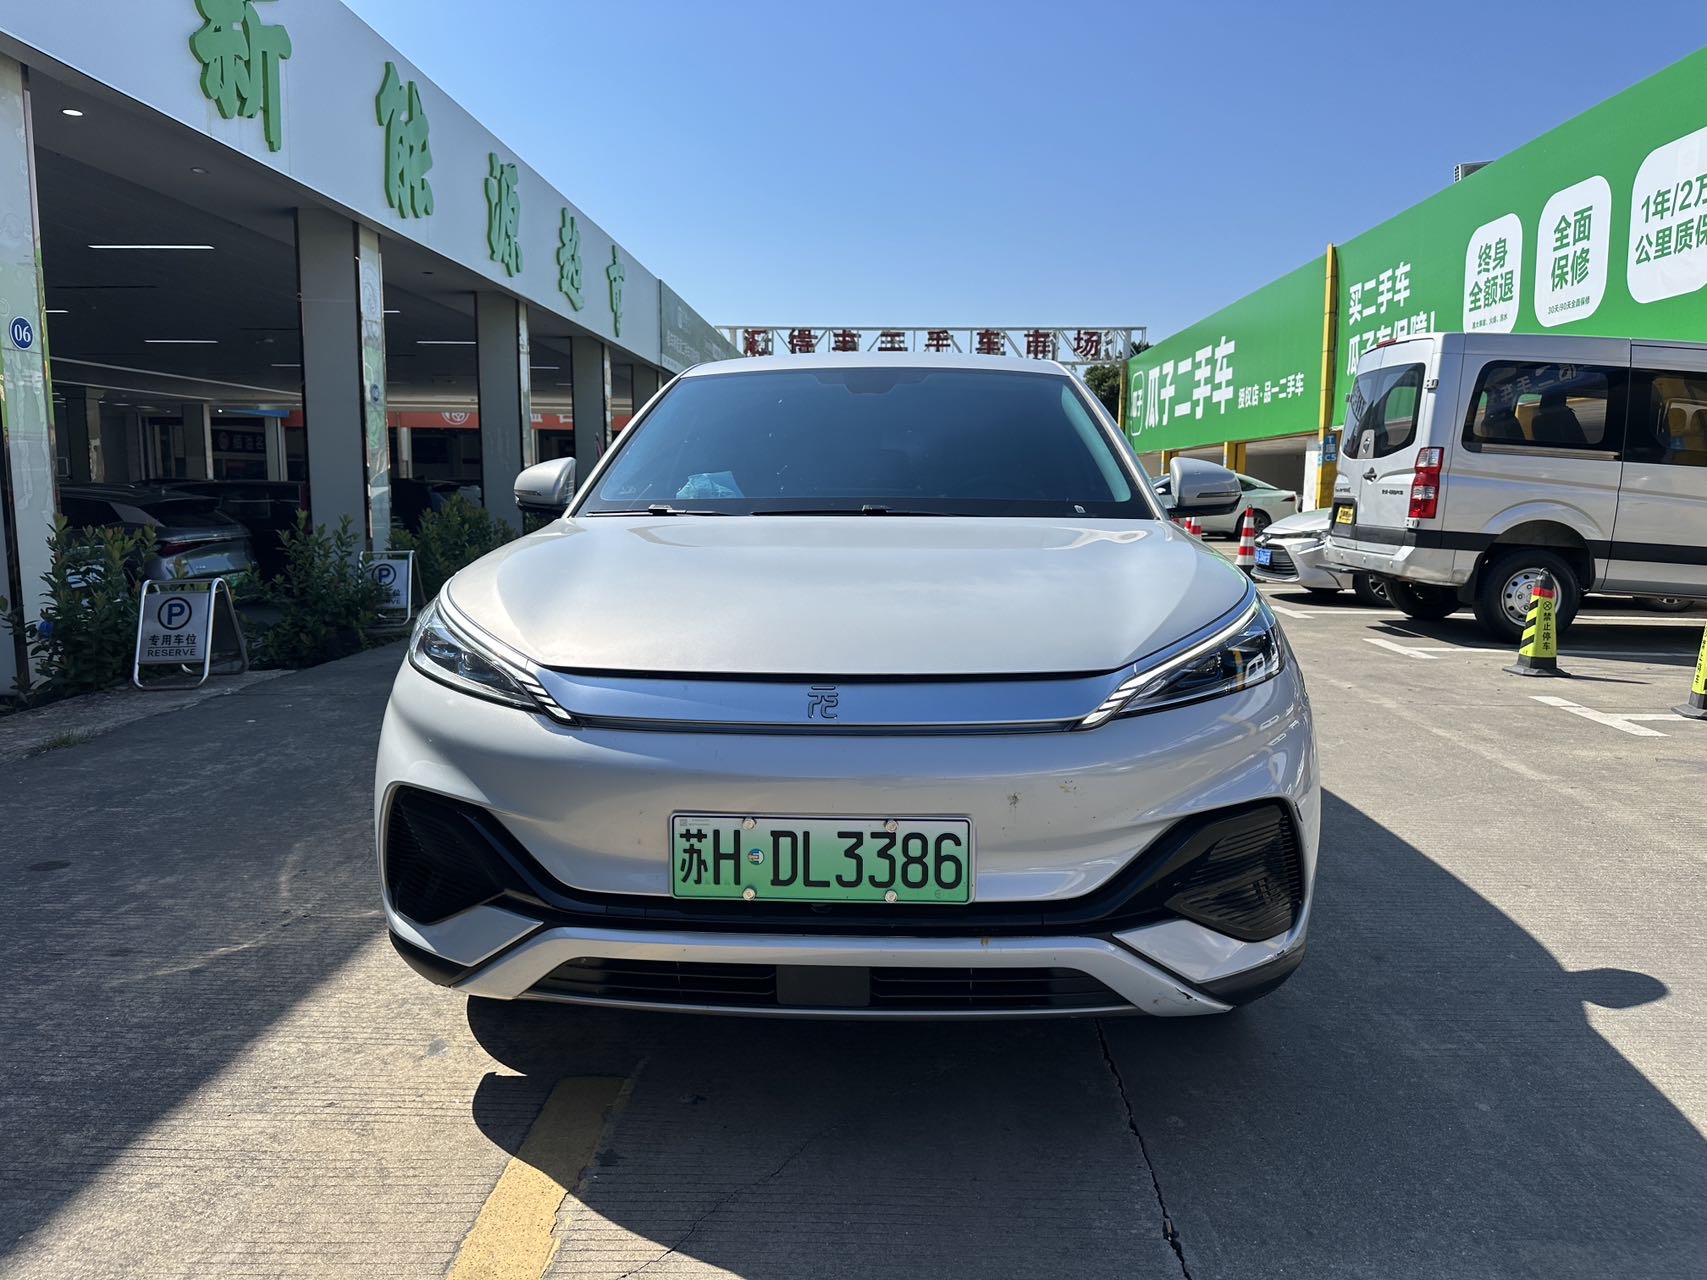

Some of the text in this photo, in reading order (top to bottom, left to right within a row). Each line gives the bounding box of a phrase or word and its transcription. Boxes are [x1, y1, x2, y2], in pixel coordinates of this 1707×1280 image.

[1553, 205, 1593, 252] 全面
[1477, 237, 1508, 276] 终身
[1551, 247, 1590, 292] 保修
[1348, 261, 1411, 326] 买二手车
[1469, 269, 1514, 312] 全额退
[14, 323, 31, 343] 06
[1145, 335, 1236, 429] 瓜子二手车
[149, 633, 197, 646] 专用车位
[1542, 612, 1552, 651] 禁止停车
[147, 648, 197, 657] RESERVE
[807, 685, 839, 719] 元
